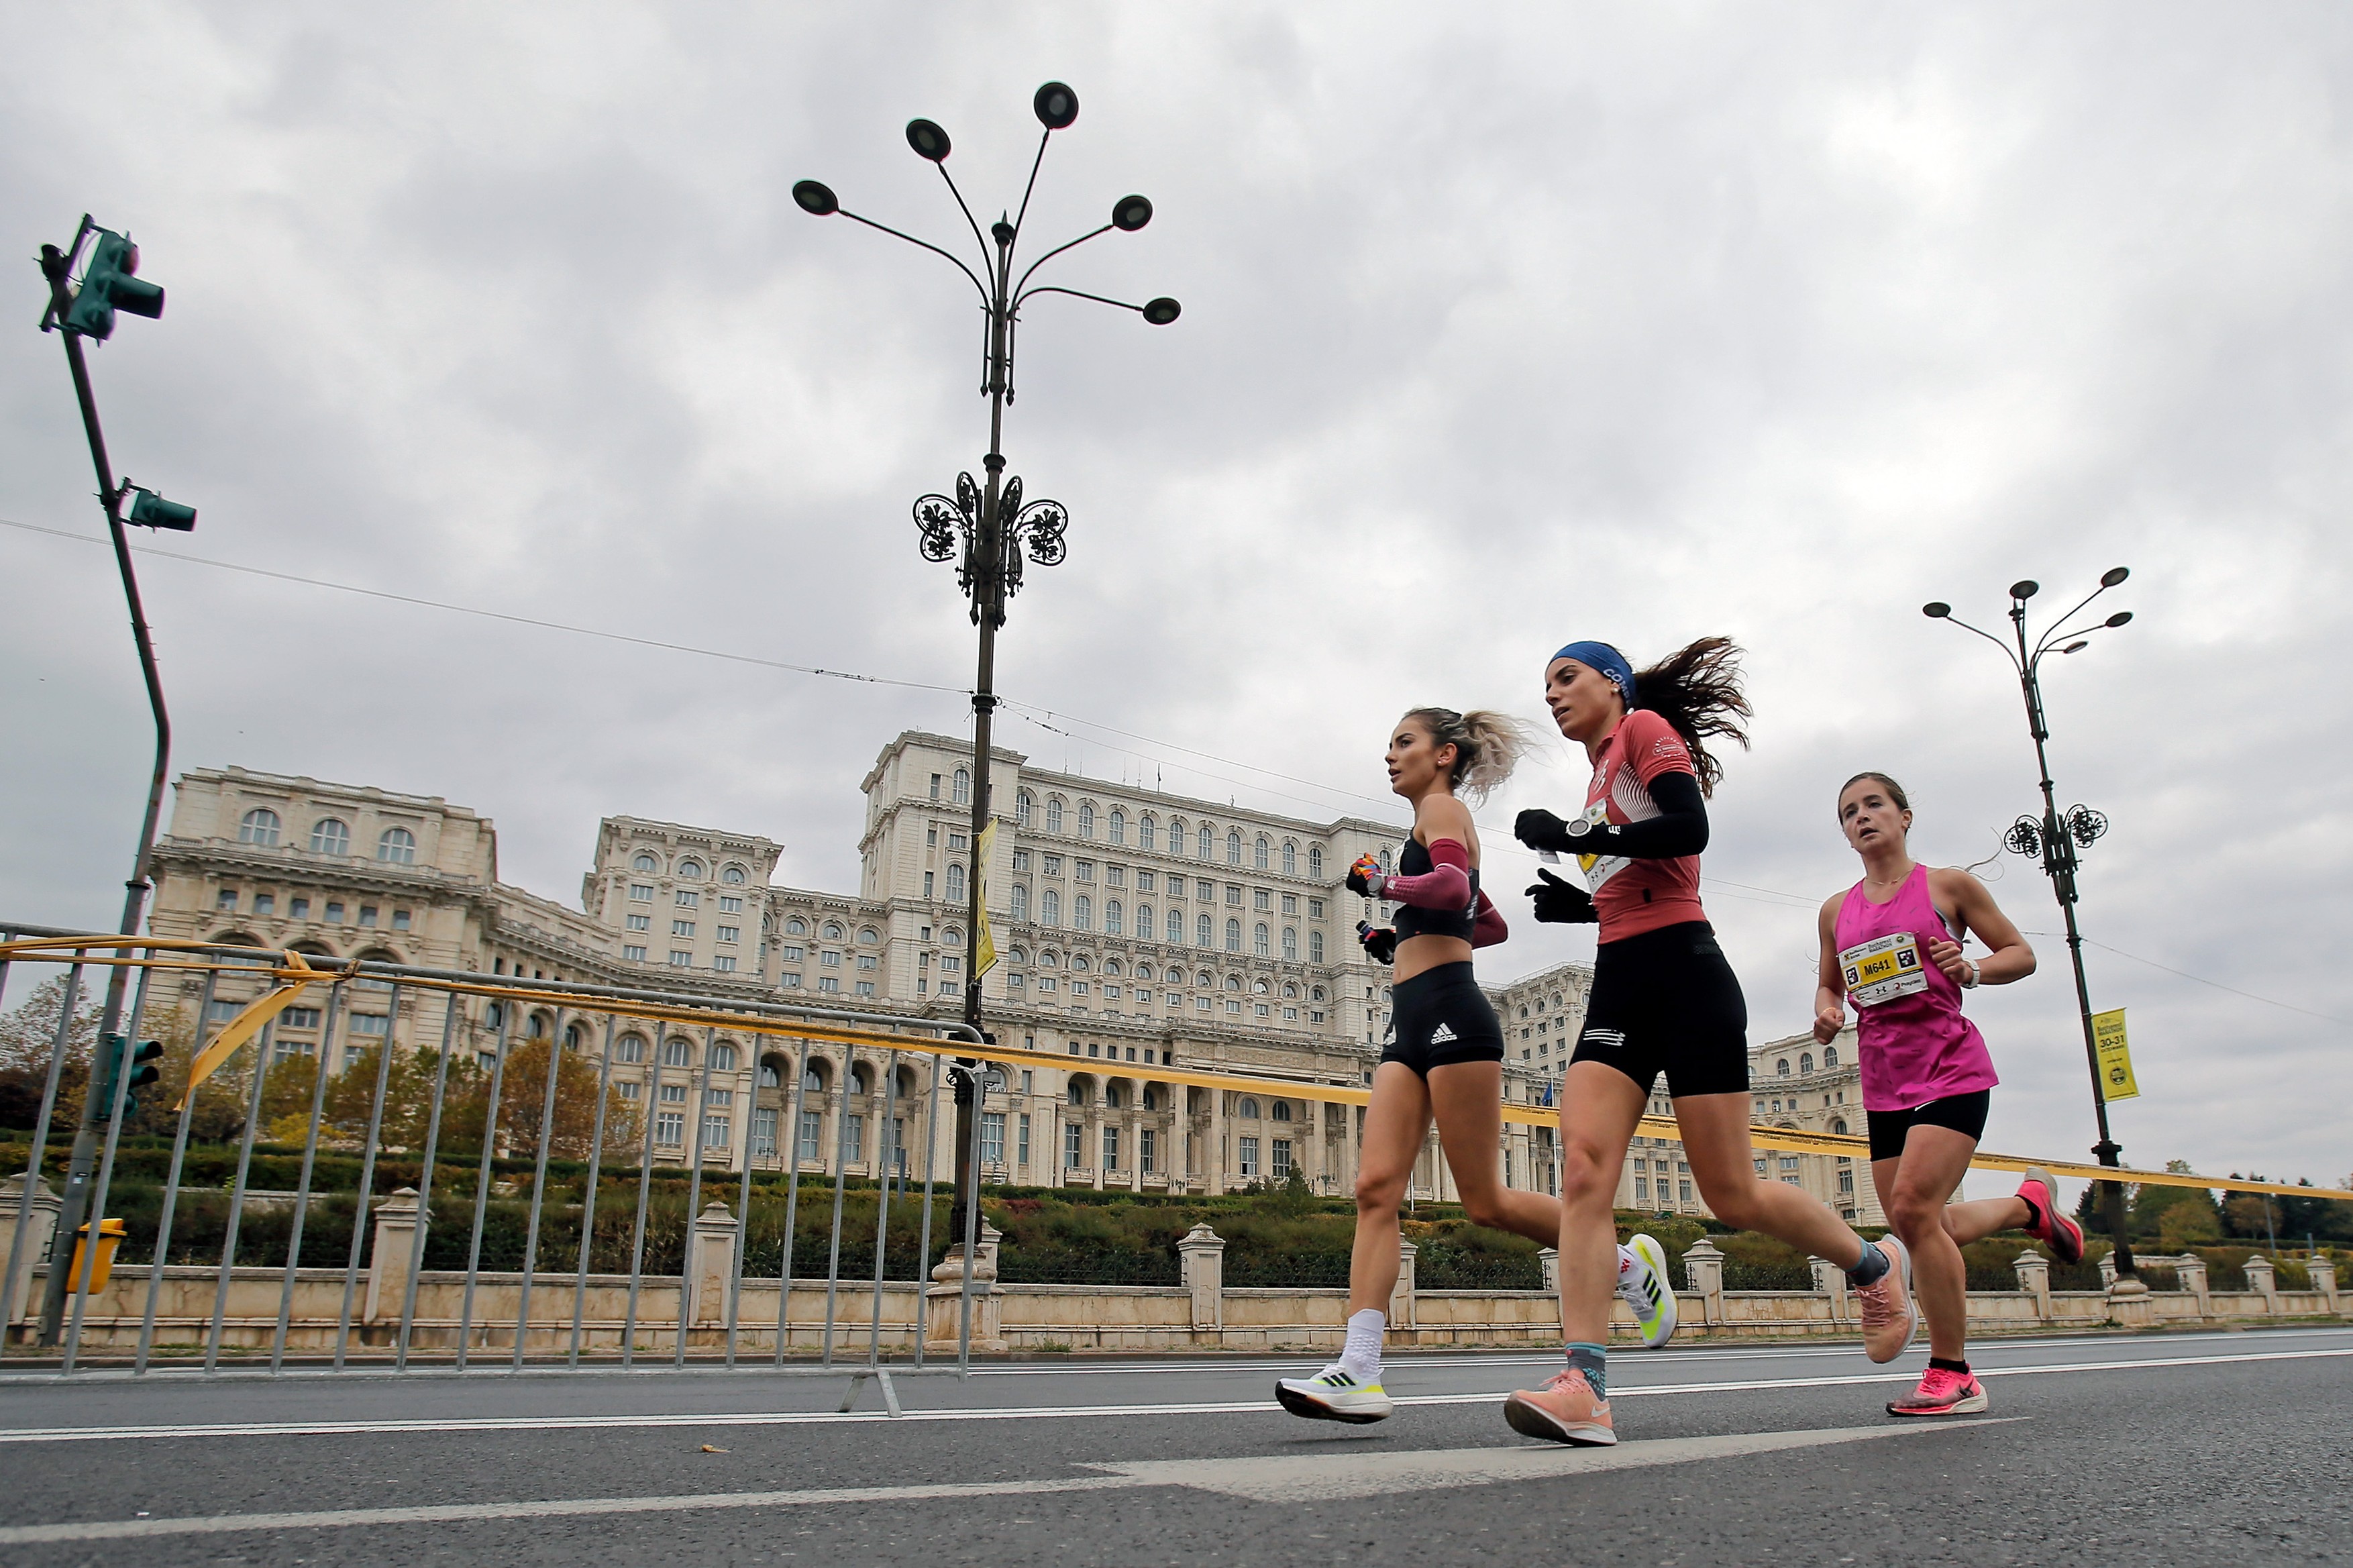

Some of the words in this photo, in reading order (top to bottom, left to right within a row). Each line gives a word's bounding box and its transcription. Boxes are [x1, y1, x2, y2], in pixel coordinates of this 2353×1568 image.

[1864, 959, 1891, 976] M641
[1431, 1034, 1457, 1045] adidas
[2099, 1035, 2124, 1048] 30-31
